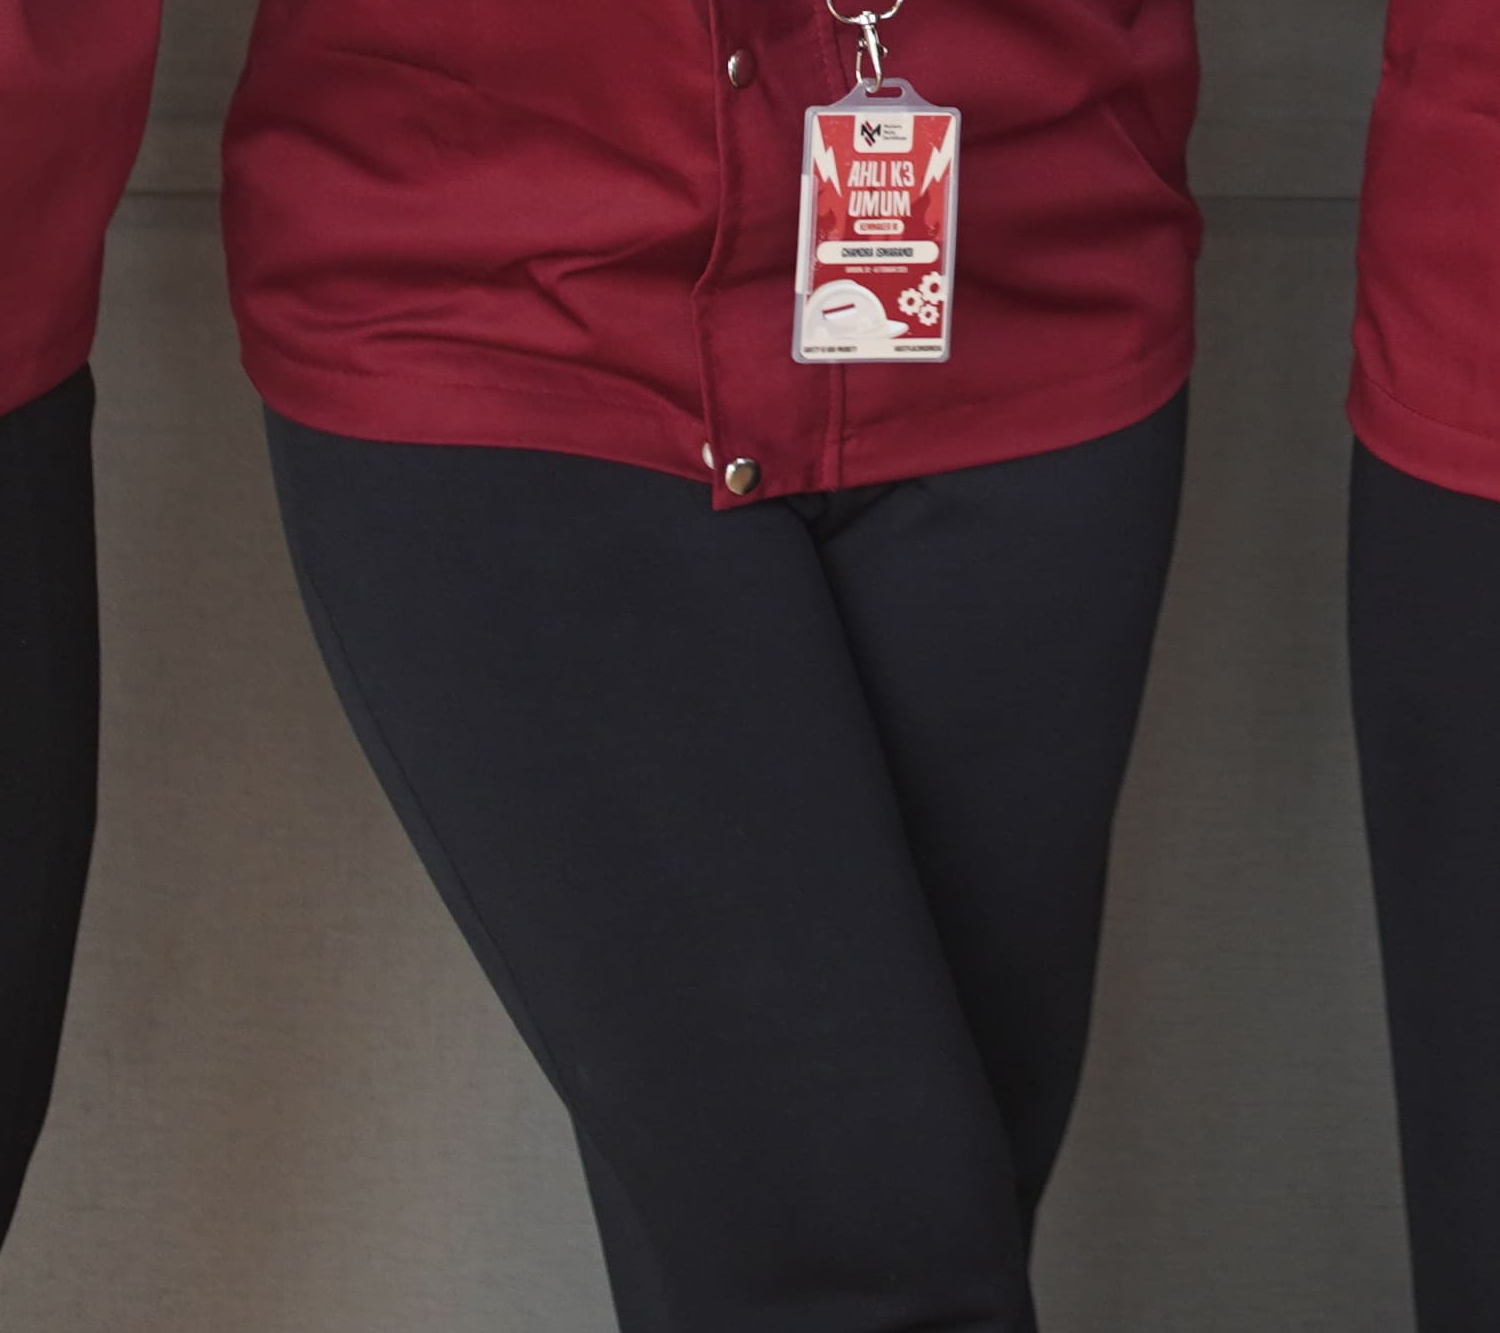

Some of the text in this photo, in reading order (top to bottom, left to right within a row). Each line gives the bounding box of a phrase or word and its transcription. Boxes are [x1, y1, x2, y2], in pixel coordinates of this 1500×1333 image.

[847, 160, 915, 187] AHLI K3
[849, 191, 912, 218] UMUM
